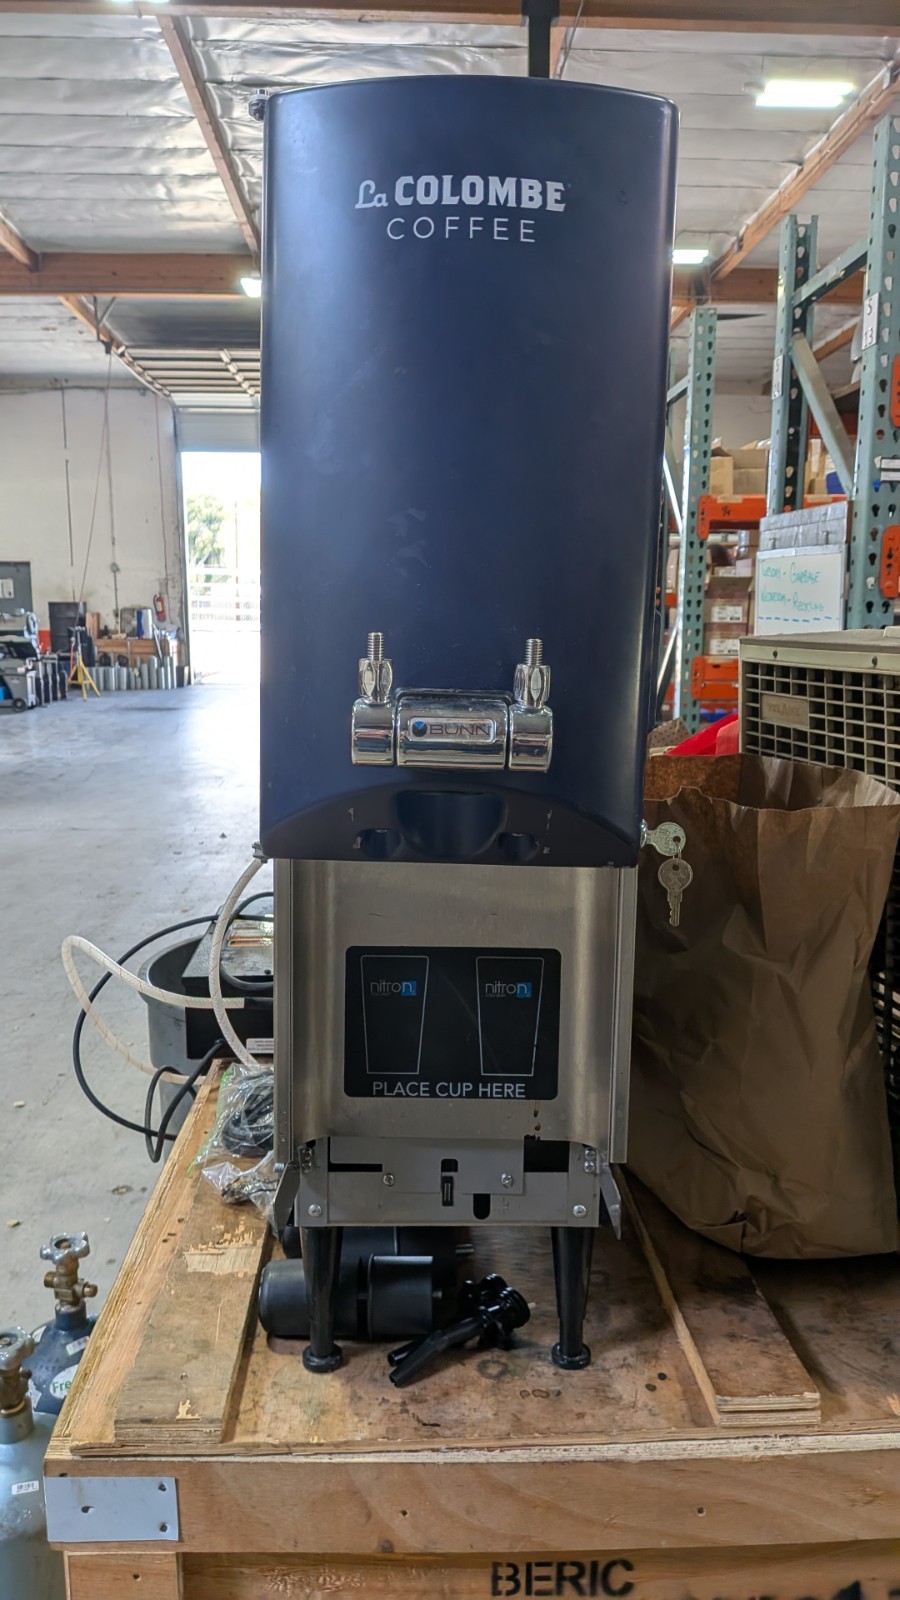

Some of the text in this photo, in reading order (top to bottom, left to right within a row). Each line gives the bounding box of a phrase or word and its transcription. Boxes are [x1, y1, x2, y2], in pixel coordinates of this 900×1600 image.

[355, 174, 566, 212] La COLOMBE
[386, 216, 536, 243] COFFEE
[429, 724, 492, 736] BUNN
[372, 1081, 526, 1098] PLACE CUP HERE
[490, 1558, 635, 1597] BERIC
